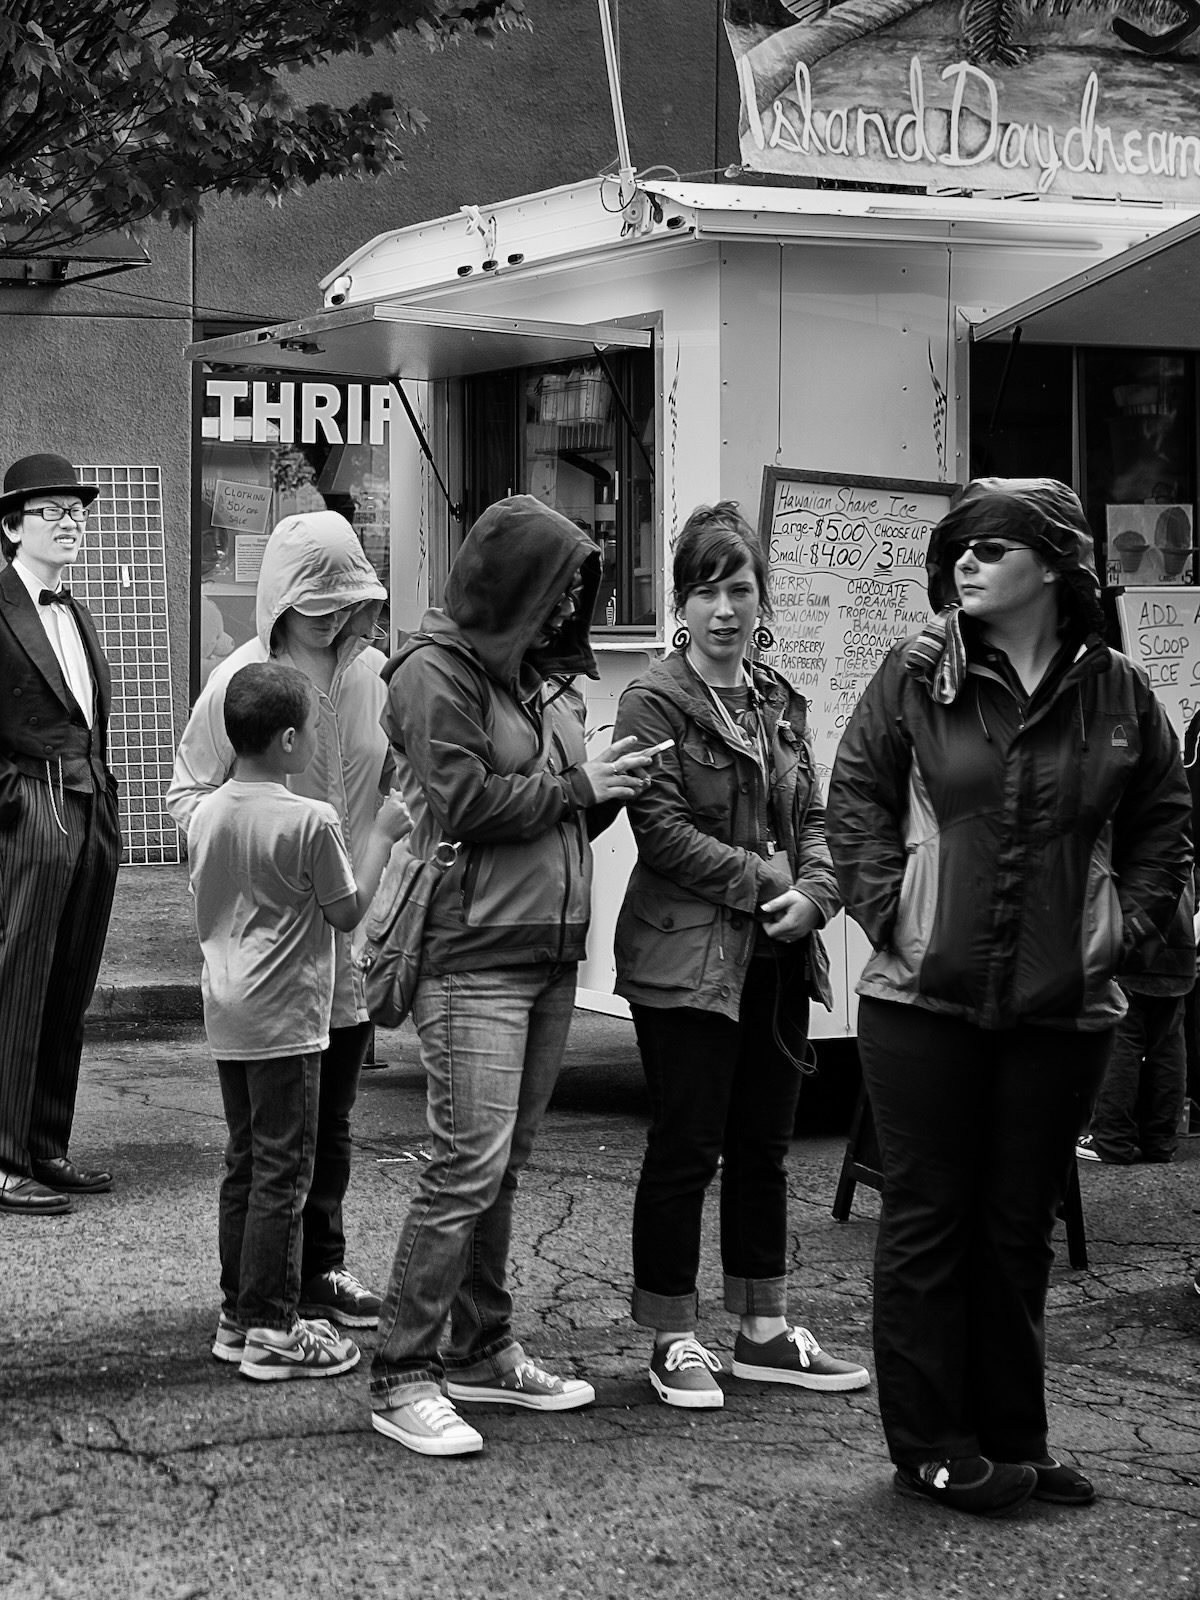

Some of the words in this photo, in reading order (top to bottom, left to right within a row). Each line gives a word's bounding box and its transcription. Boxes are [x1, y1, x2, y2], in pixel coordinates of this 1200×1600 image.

[742, 54, 937, 163] Island
[224, 486, 266, 501] CLOTHING
[778, 484, 832, 510] Hawaiian
[835, 487, 879, 514] Shave
[884, 495, 918, 519] Ice
[226, 501, 246, 512] 50%
[874, 523, 910, 539] CHOOSE
[877, 541, 894, 569] 3
[768, 575, 813, 594] CHERRY
[847, 580, 909, 598] CHOCOLATE
[807, 593, 831, 607] GUM
[855, 595, 909, 608] ORANGE
[800, 609, 830, 625] CANDY
[838, 605, 888, 621] TROPICAL
[894, 608, 929, 623] PUNCH
[1139, 601, 1178, 626] ADD
[853, 619, 908, 637] BANANA
[779, 637, 826, 657] RASPBERRY
[1138, 634, 1190, 656] SCOOP
[781, 653, 828, 673] RASPBERRY
[1145, 662, 1180, 683] ICE
[829, 677, 858, 691] BLUE
